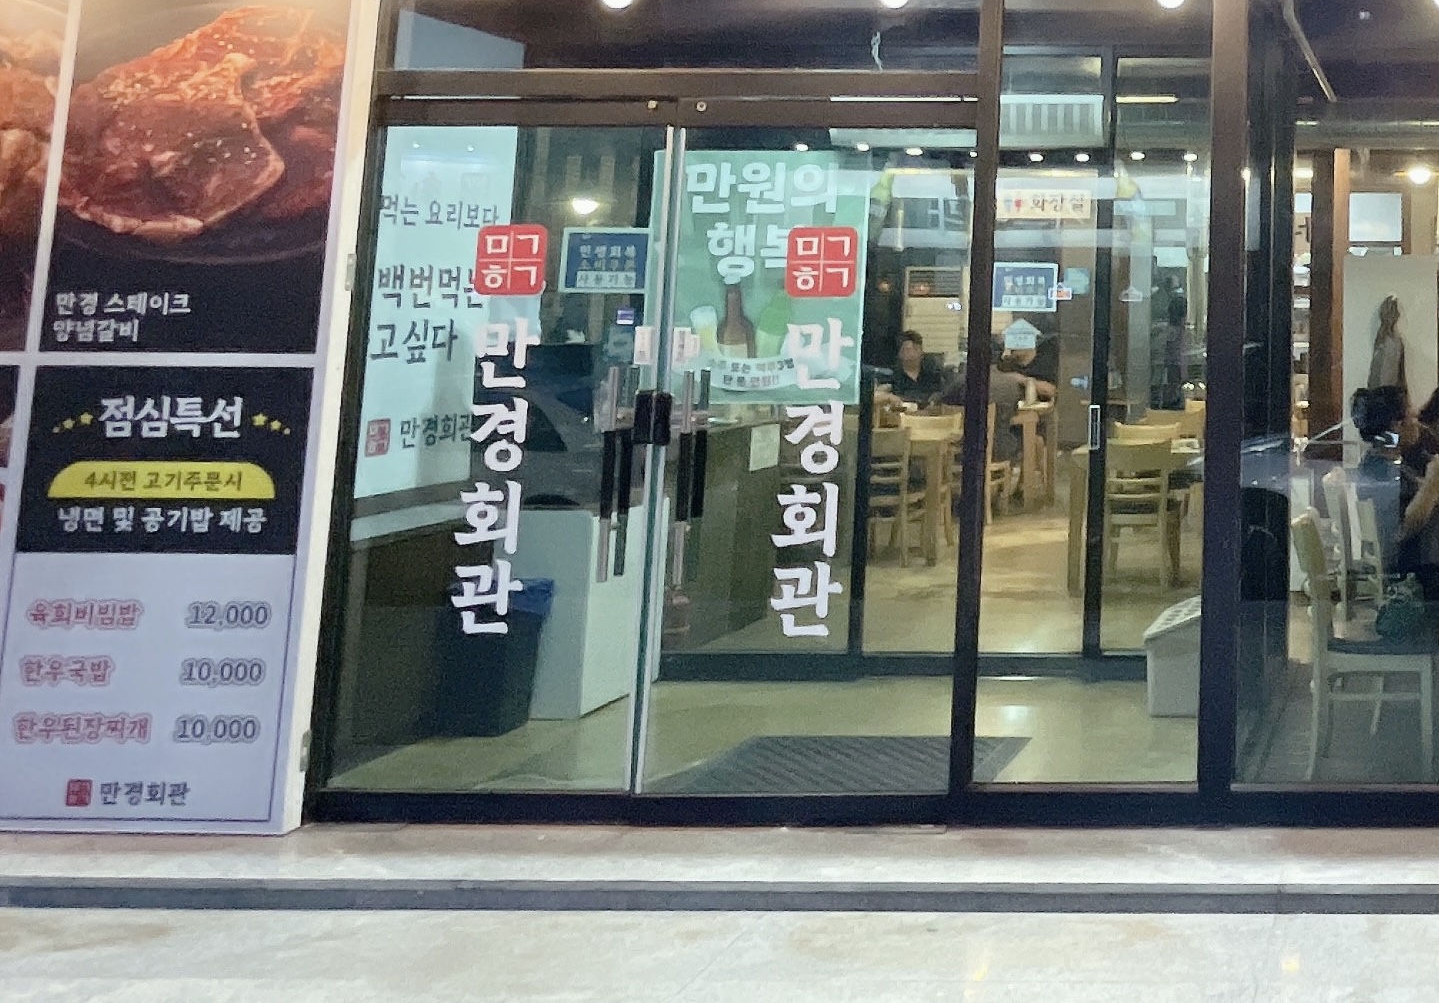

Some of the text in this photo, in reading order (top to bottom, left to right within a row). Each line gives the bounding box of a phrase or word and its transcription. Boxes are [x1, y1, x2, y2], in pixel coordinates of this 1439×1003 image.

[686, 161, 840, 215] 만원의
[56, 291, 192, 316] 만경 스테이크
[53, 318, 139, 342] 양념갈비
[370, 318, 459, 365] 고싶다
[100, 396, 243, 438] 점심특선
[84, 470, 136, 491] 4시전
[451, 317, 540, 634] 만경회관
[770, 317, 854, 637] 만경회관
[57, 506, 267, 533] 냉면 및 공기밥 제공
[28, 600, 270, 628] 육회비빔밥 12,000
[22, 658, 264, 684] 한우국밥 10,000
[16, 715, 258, 741] 한우된장찌개 10,000
[100, 781, 191, 806] 만경회관
